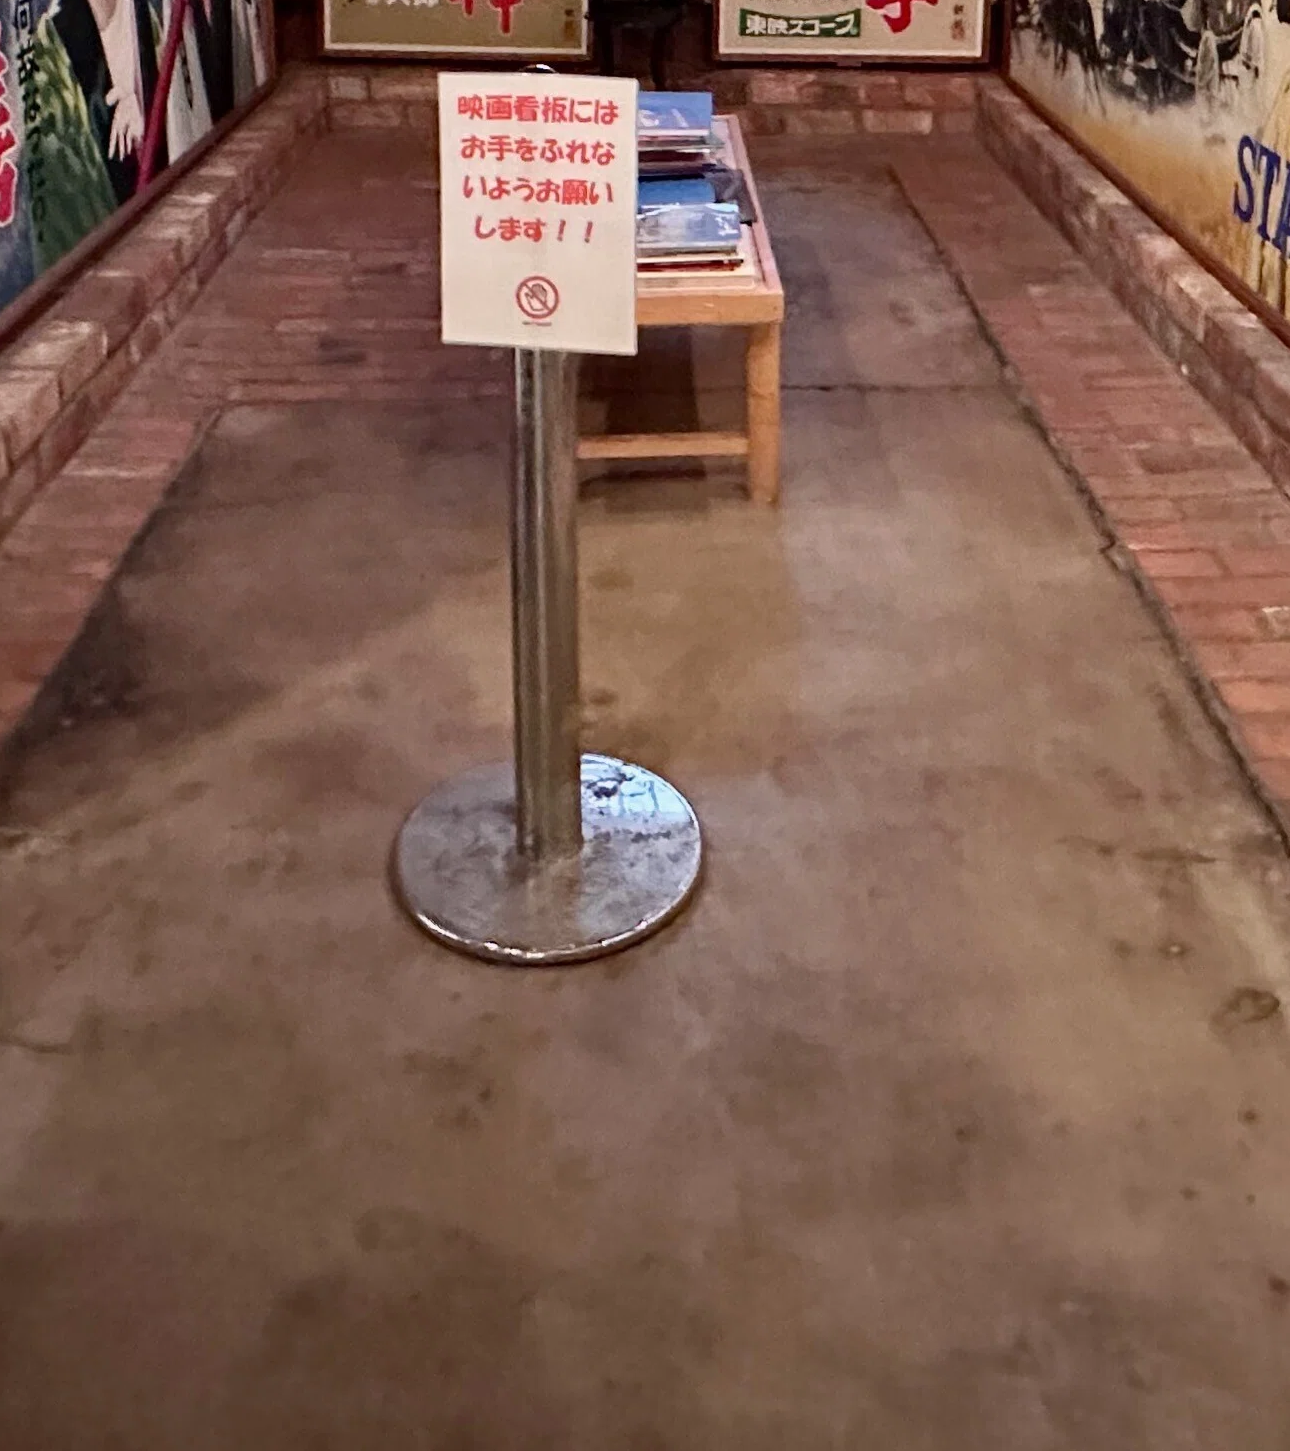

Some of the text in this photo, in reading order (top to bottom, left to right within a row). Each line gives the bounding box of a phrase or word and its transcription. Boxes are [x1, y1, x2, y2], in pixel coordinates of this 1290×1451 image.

[745, 12, 860, 37] 東映スコープ
[457, 95, 619, 125] 映画看板には
[460, 135, 616, 166] お手をふれな
[463, 176, 614, 205] いようお願い
